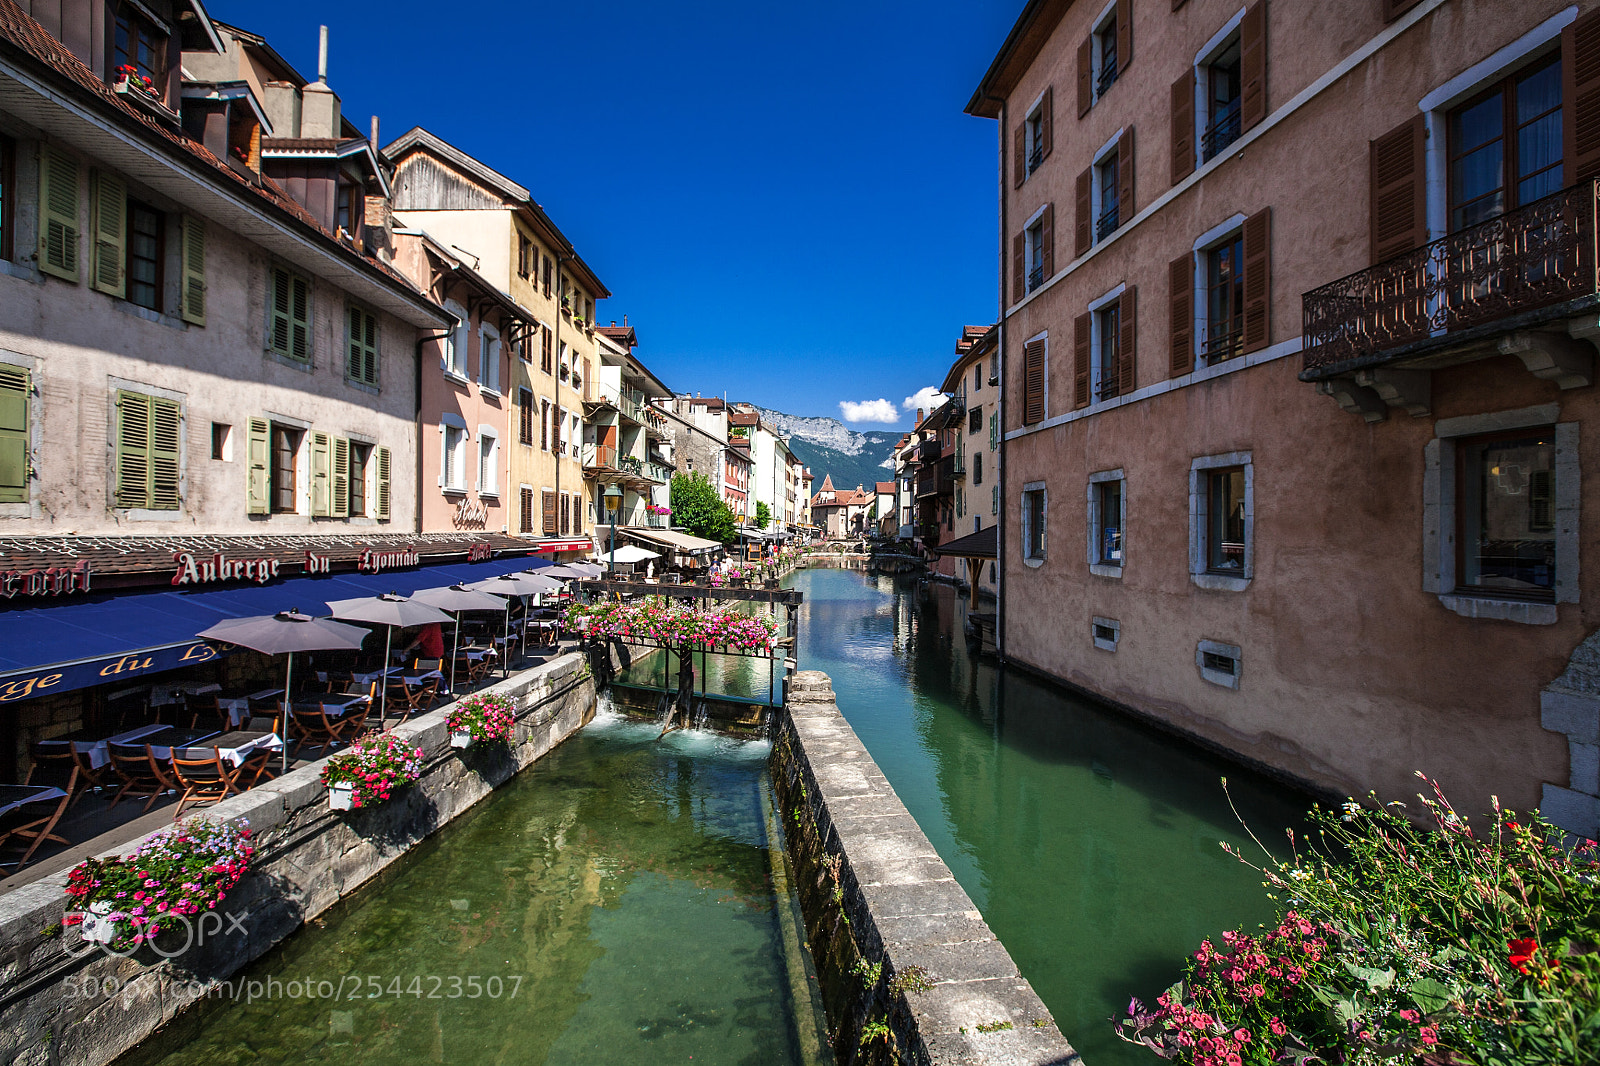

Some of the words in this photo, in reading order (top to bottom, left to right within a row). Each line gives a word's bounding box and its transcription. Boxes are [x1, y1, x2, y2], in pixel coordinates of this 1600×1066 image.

[171, 551, 280, 586] Auberge
[303, 550, 331, 574] du
[358, 546, 420, 575] Lyonnais
[100, 654, 154, 677] du
